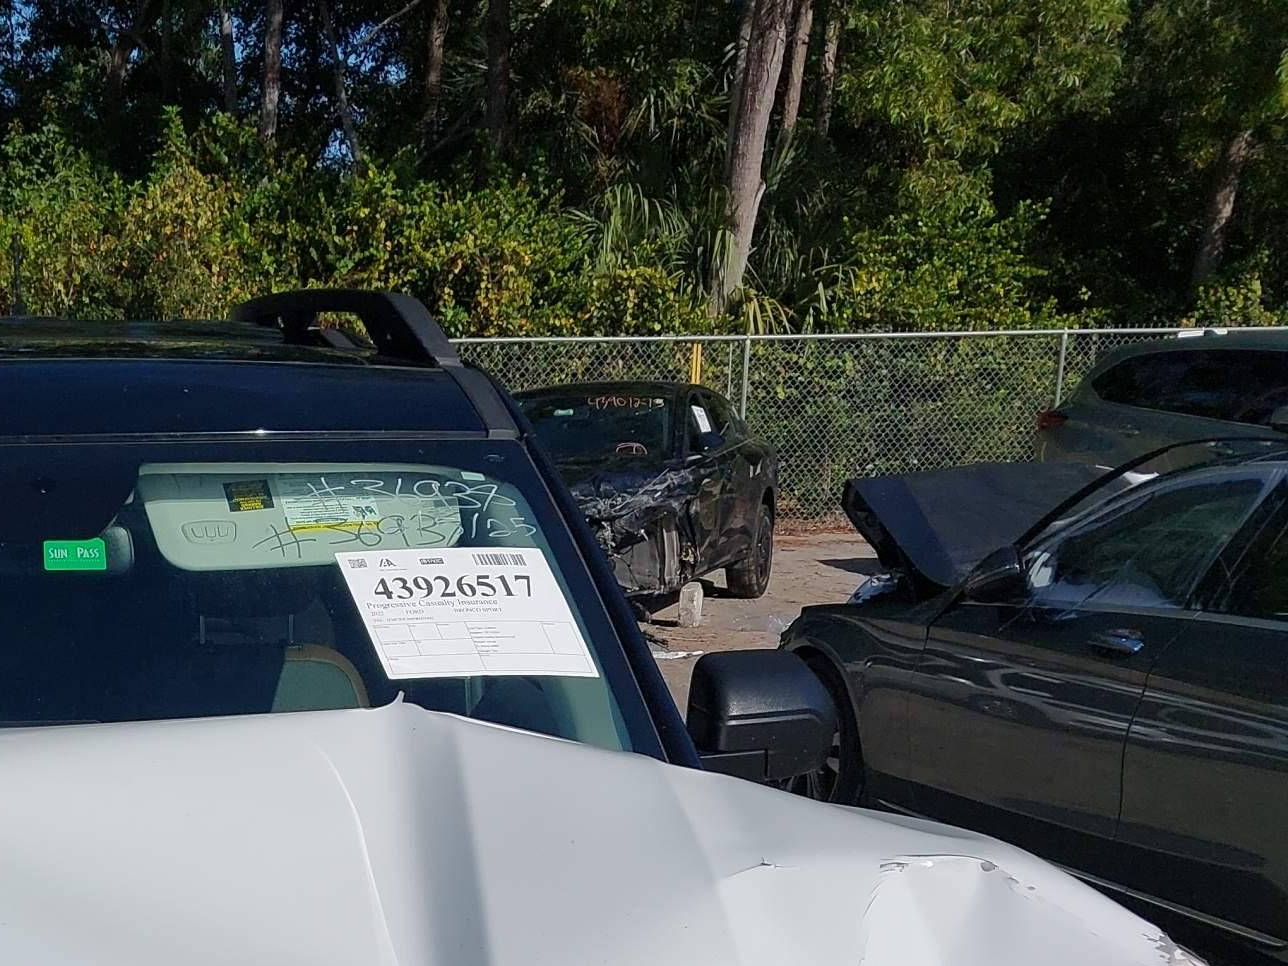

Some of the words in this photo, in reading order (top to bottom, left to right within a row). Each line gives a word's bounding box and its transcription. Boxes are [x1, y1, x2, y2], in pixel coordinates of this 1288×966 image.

[48, 547, 68, 559] SUN
[76, 546, 100, 558] PASS
[373, 575, 532, 600] 43926517
[366, 600, 417, 611] Progressive
[418, 599, 456, 609] Casualty
[457, 598, 499, 606] Insurance
